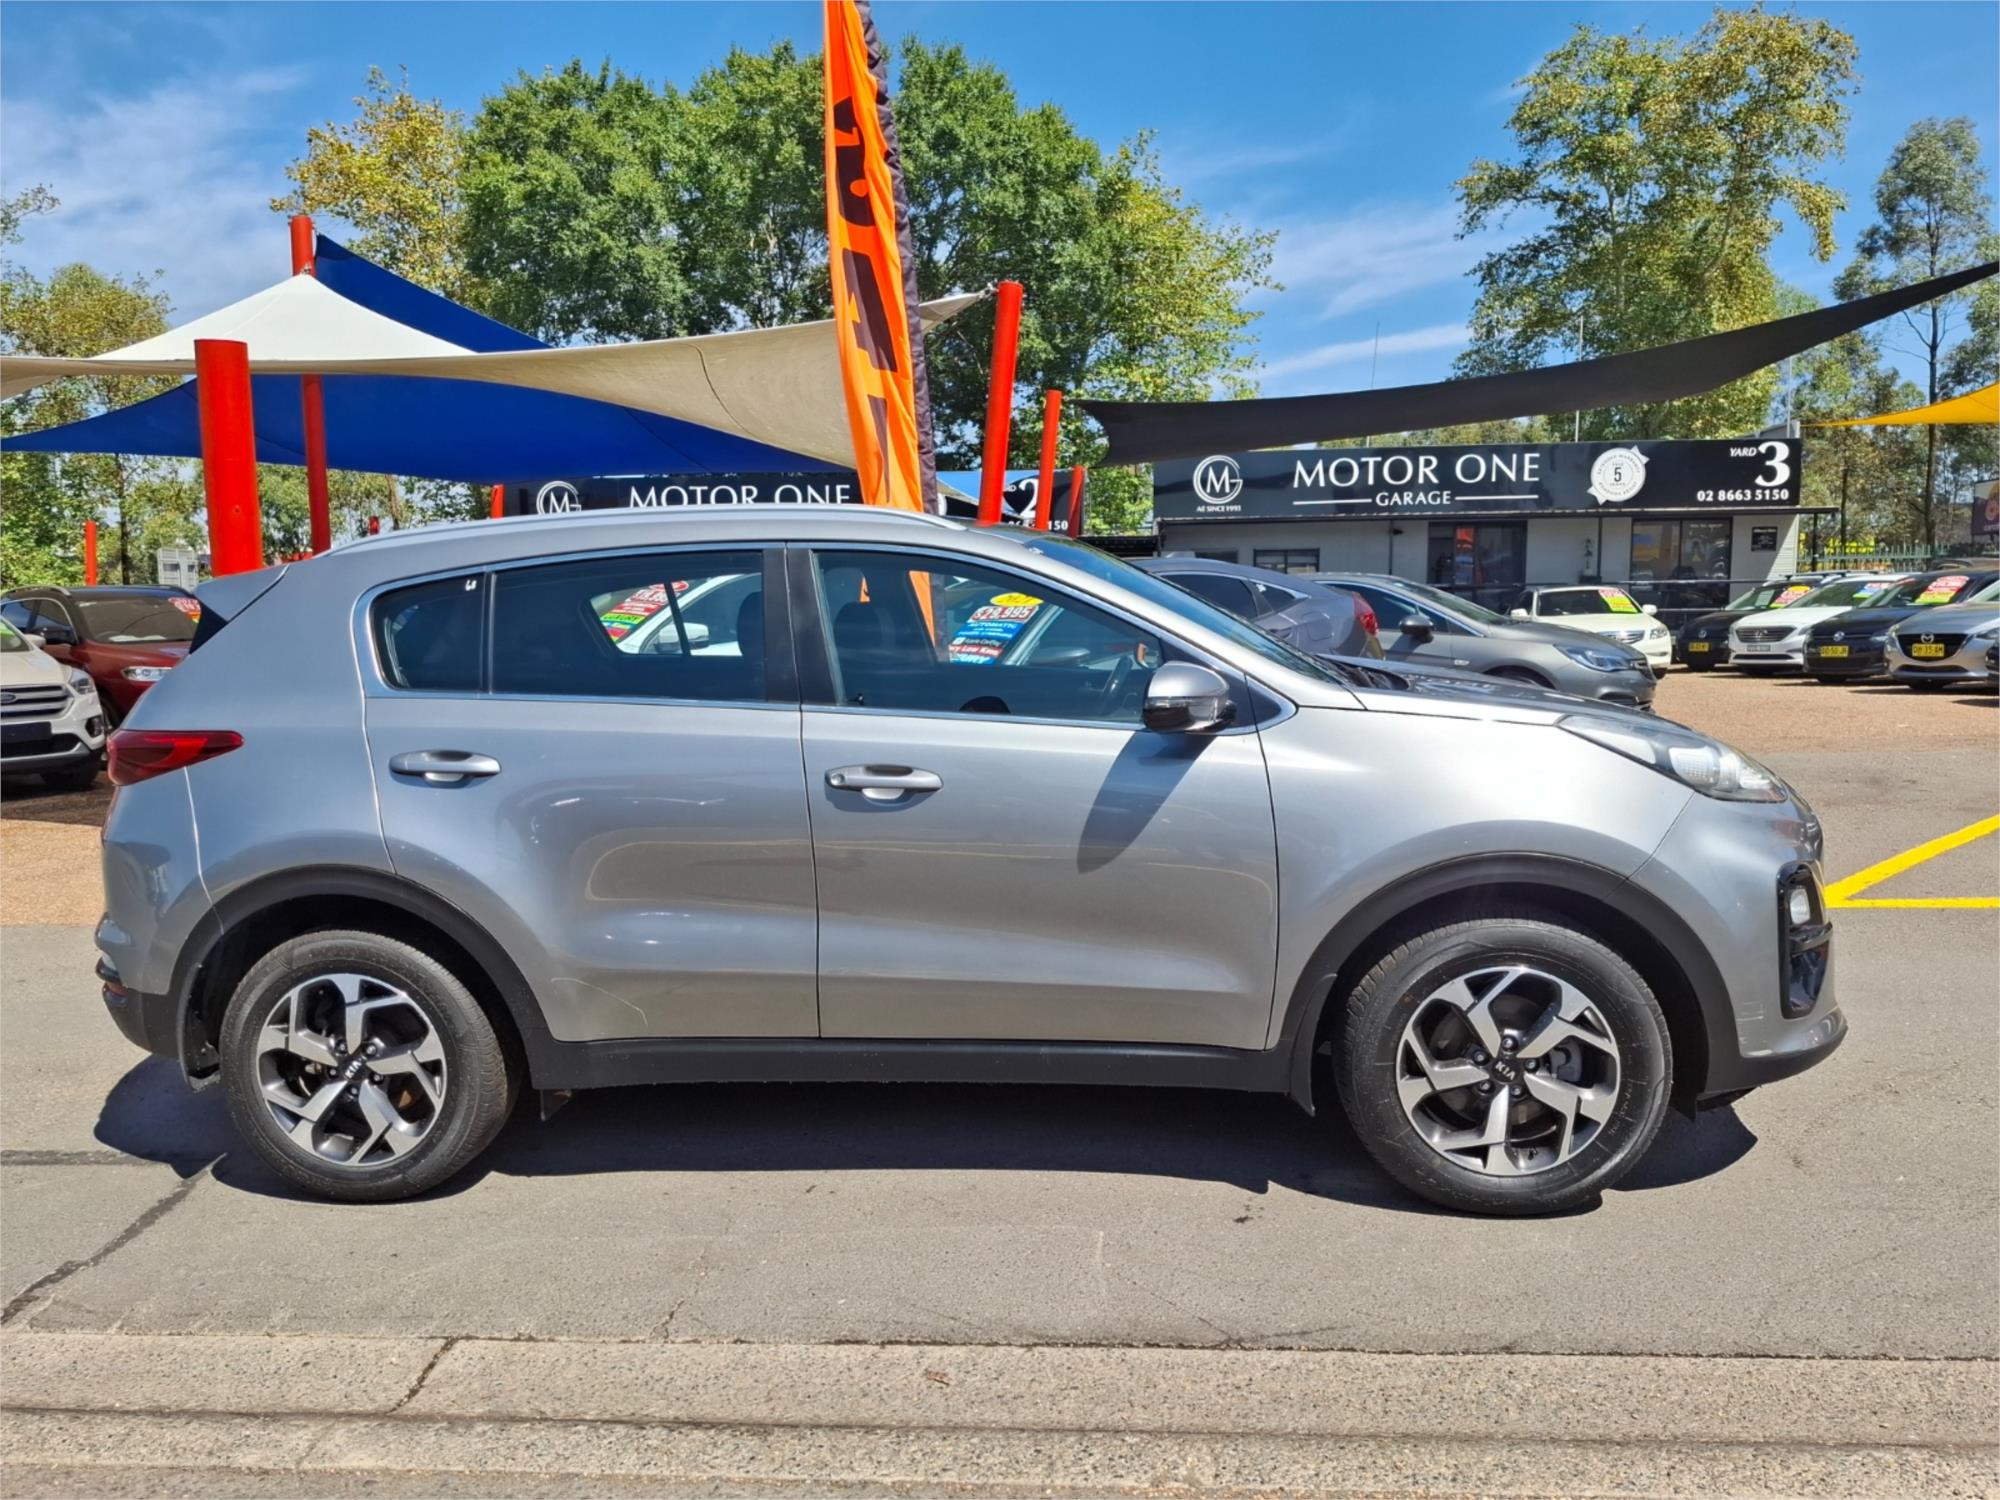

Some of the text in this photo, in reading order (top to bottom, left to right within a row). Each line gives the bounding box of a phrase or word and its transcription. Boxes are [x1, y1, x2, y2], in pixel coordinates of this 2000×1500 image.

[1293, 453, 1540, 488] MOTOR ONE
[1729, 441, 1791, 487] YARD 3
[1613, 466, 1622, 482] 5
[629, 484, 851, 508] MOTOR ONE
[1375, 490, 1451, 507] GARAGE
[1696, 488, 1790, 502] 02 8663 5150
[1046, 520, 1069, 530] 150
[345, 1060, 362, 1079] KIA
[1495, 1061, 1516, 1080] KIA
